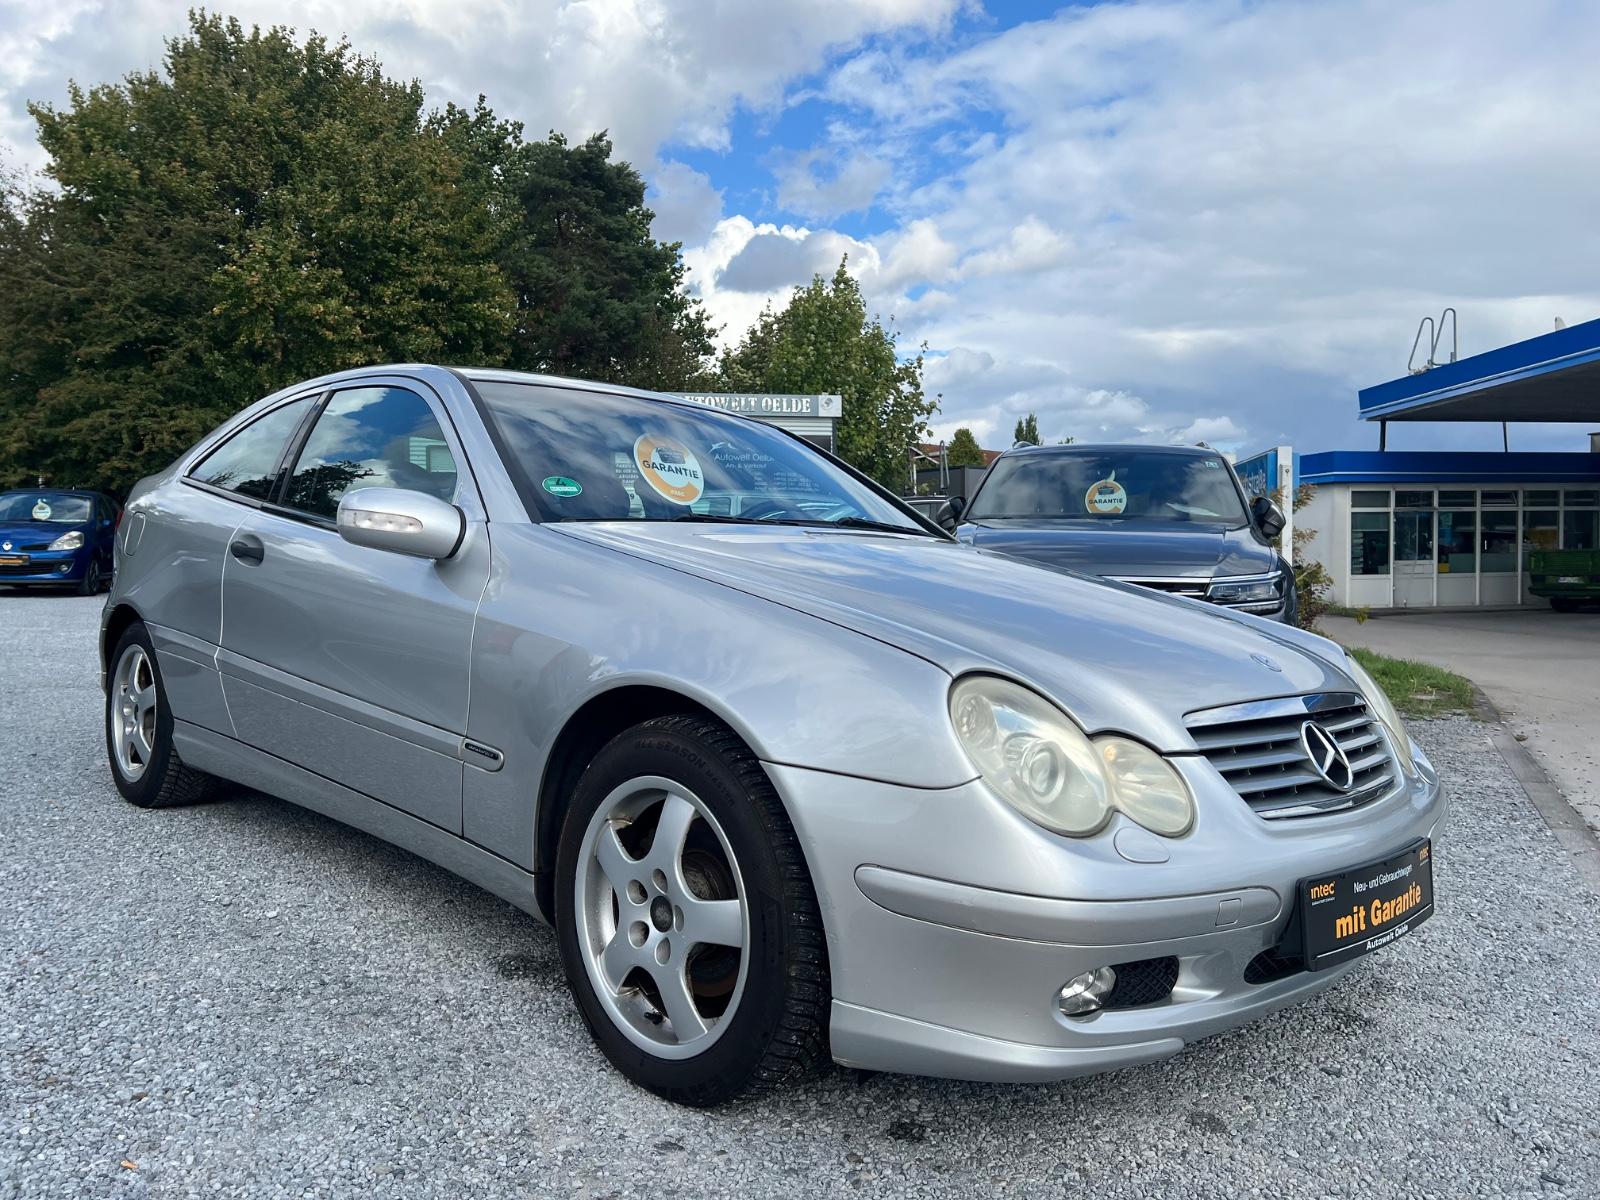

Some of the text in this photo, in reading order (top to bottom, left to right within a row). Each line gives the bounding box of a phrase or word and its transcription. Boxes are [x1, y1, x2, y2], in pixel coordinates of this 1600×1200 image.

[761, 397, 811, 412] OELDE
[642, 459, 700, 480] GARANTIE
[656, 738, 707, 769] SEASON
[1353, 882, 1368, 894] Neu-
[1368, 876, 1379, 889] und
[1335, 881, 1421, 939] mit Garantie
[1366, 931, 1395, 950] Autowelt
